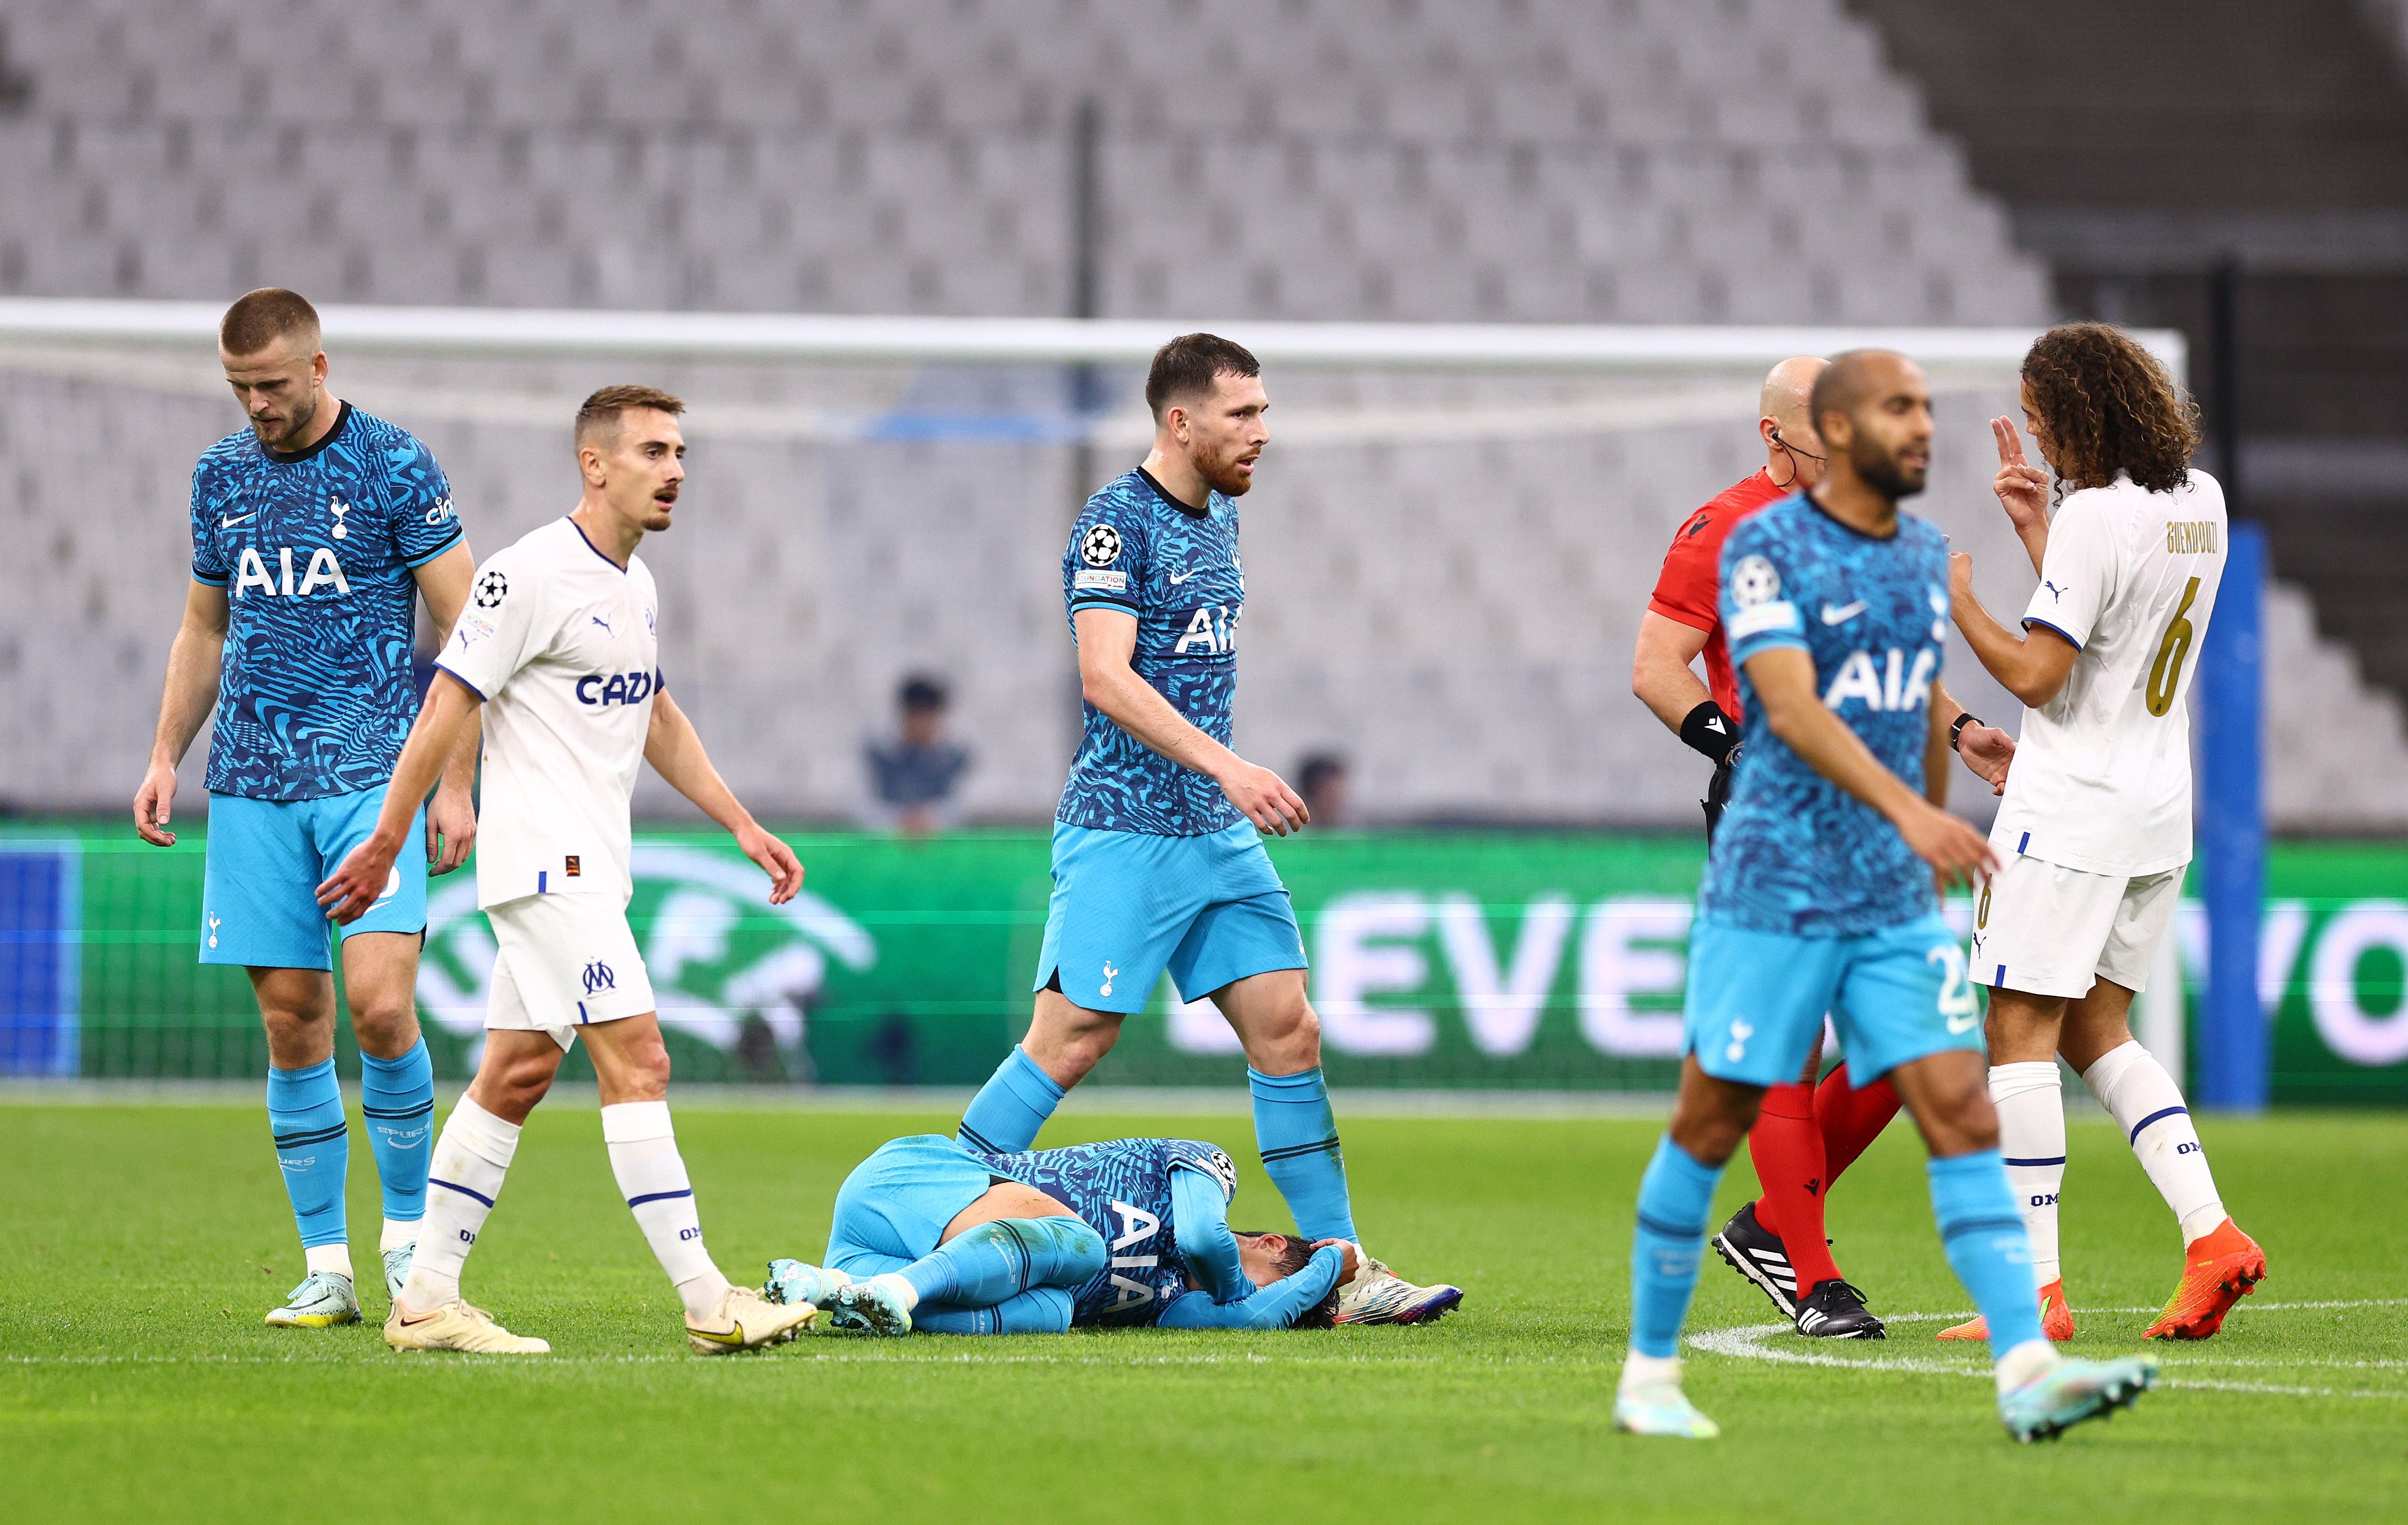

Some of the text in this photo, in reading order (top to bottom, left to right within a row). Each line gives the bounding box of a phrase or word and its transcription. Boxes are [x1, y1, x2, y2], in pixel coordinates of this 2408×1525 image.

[426, 496, 453, 525] cin
[2167, 521, 2217, 554] GUENDOUZI
[235, 547, 351, 597] AIA
[1076, 576, 1127, 584] FOUNDATION
[2146, 577, 2201, 717] 6
[377, 1121, 430, 1138] SPURS
[2031, 1193, 2059, 1207] OM
[1103, 1199, 1160, 1313] AIA
